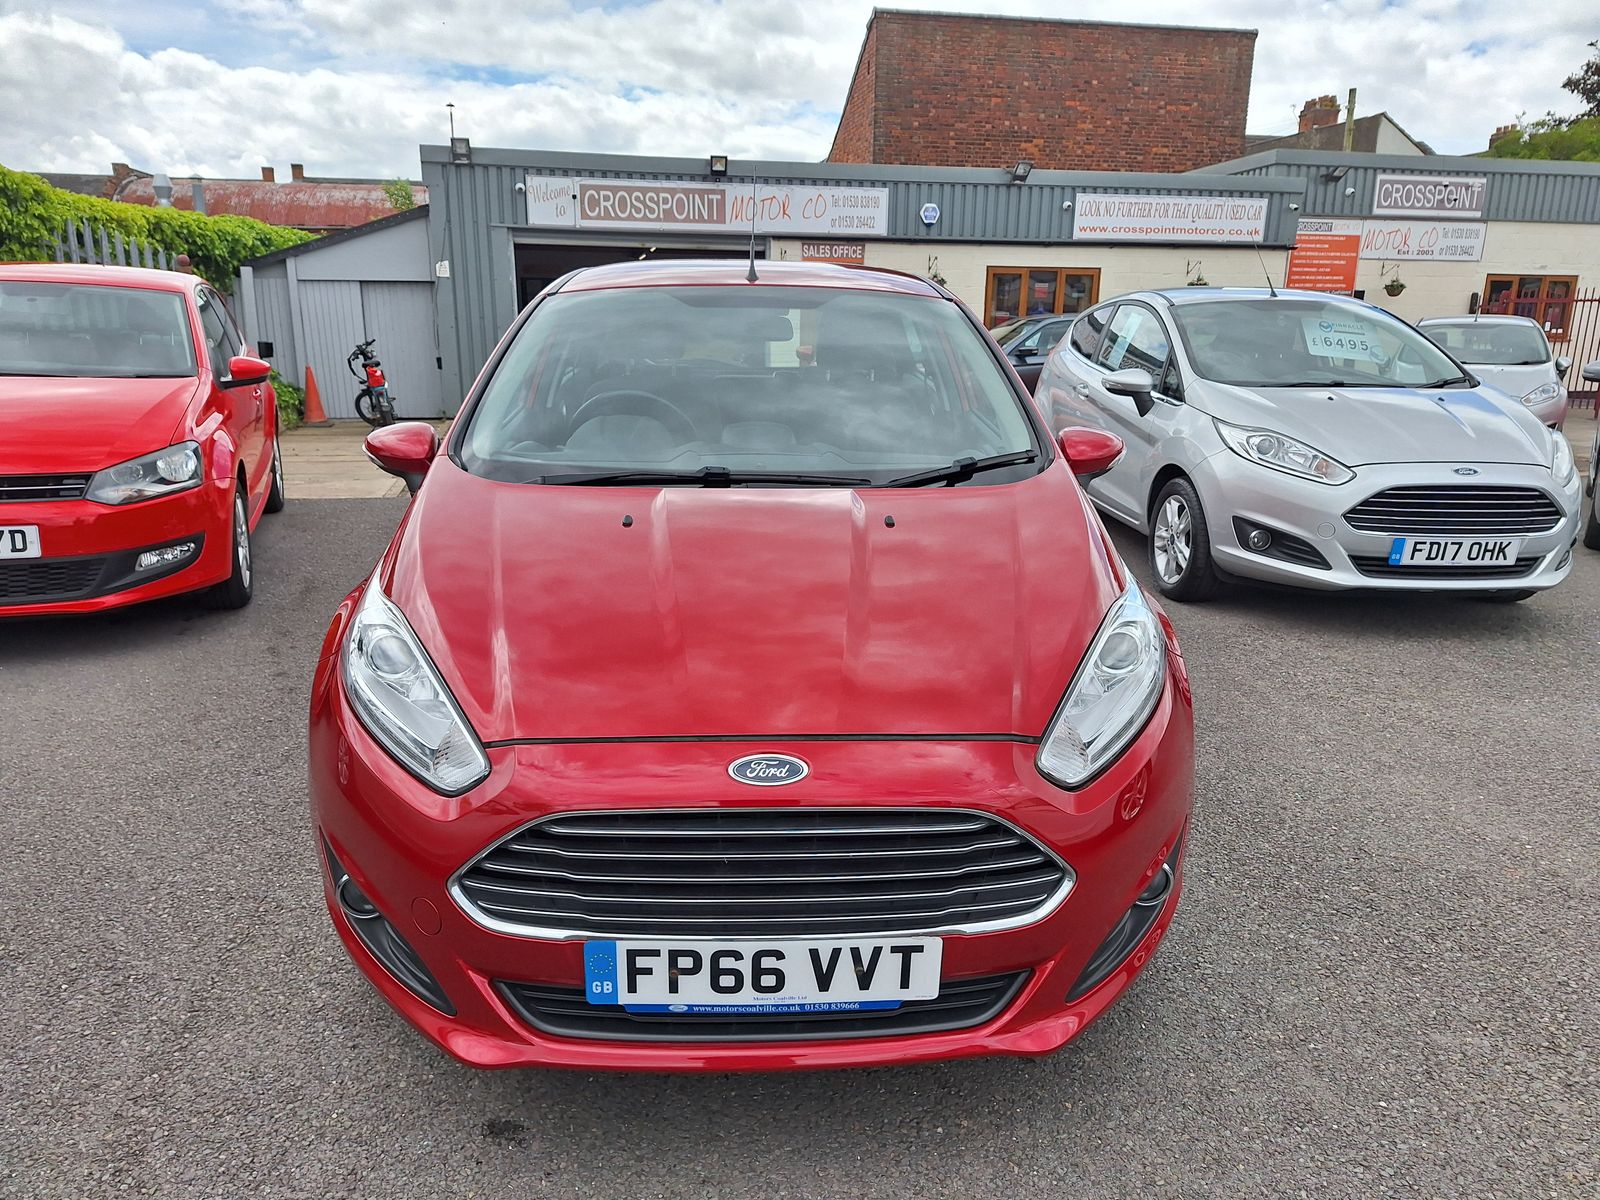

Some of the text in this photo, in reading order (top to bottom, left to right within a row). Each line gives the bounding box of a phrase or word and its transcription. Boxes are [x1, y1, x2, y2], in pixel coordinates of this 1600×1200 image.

[528, 182, 571, 204] Welcome
[831, 195, 841, 208] Tel:
[842, 195, 859, 208] 01530
[1380, 183, 1482, 209] CROSSPOINT
[555, 202, 566, 218] to
[584, 189, 827, 224] CROSSPOINT MOTOR CO
[1079, 200, 1263, 223] LOOK NO FURTHER FOR THAT QUALITY USED CAR
[831, 215, 876, 229] or 01530 264422
[1361, 226, 1439, 252] MOTOR CO
[803, 245, 862, 258] SALES OFFICE
[0, 530, 27, 552] D
[1410, 541, 1512, 561] FD17 OHK
[746, 760, 790, 778] Ford
[626, 945, 925, 994] FP66 VVT
[592, 981, 613, 994] GB
[693, 1004, 800, 1012] www.motorscoalville.co.uk
[831, 1002, 860, 1010] 839666
